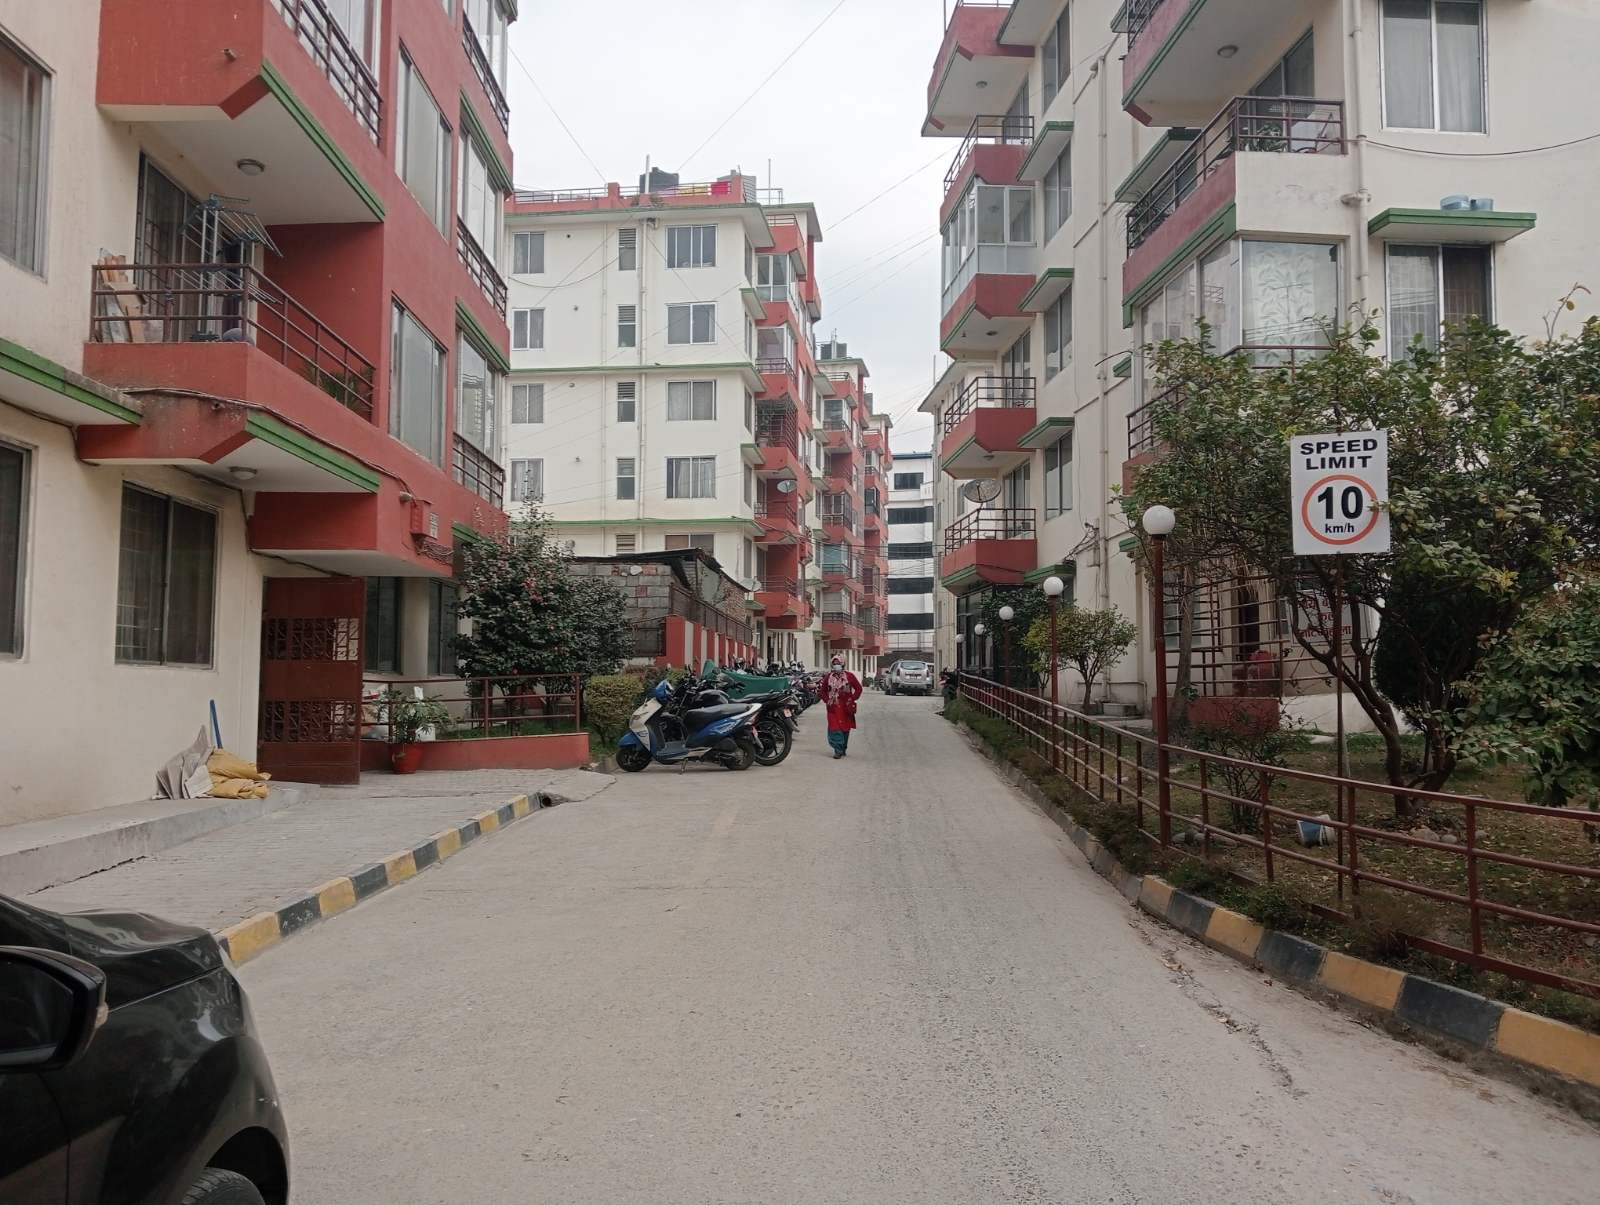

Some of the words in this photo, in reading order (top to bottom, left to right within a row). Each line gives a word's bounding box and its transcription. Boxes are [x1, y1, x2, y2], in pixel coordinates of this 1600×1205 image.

[1300, 439, 1378, 455] SPEED
[1306, 456, 1372, 470] LIMIT
[1317, 486, 1364, 519] 10
[1324, 523, 1355, 533] km/h
